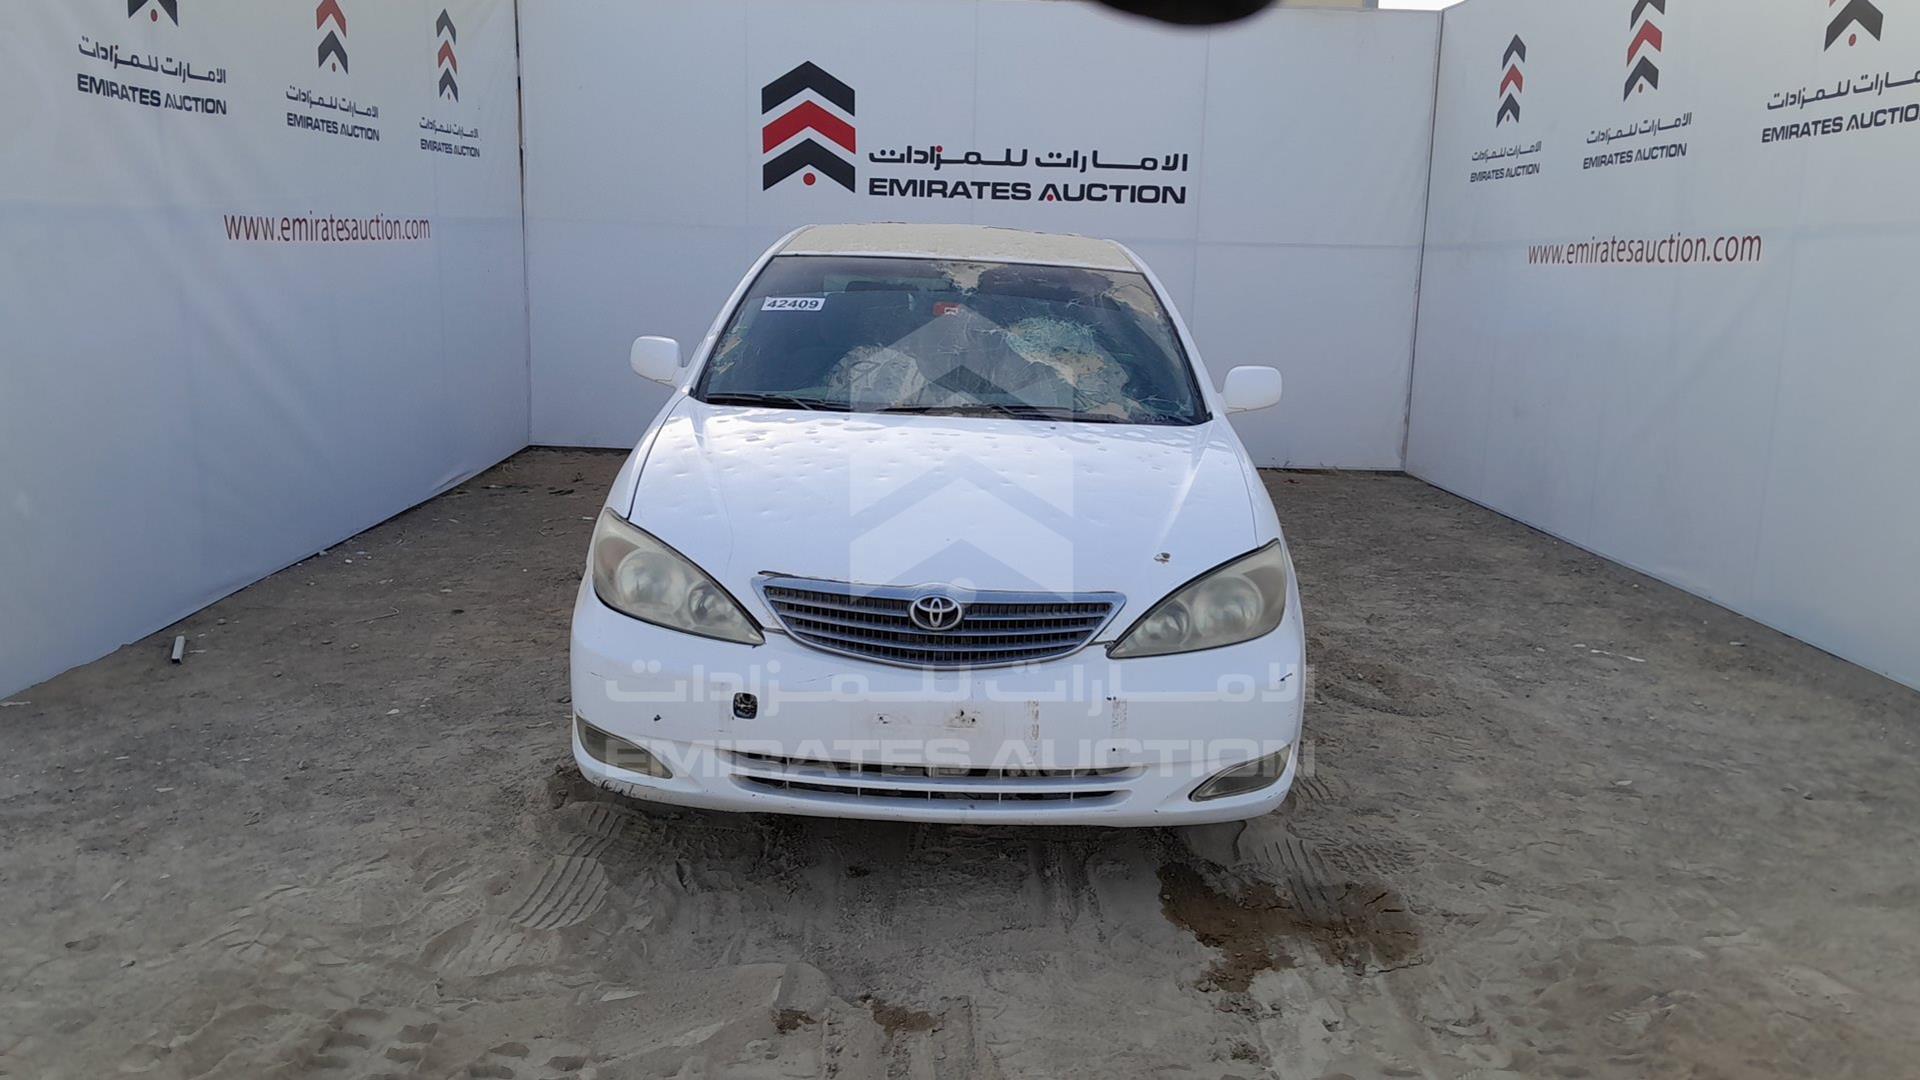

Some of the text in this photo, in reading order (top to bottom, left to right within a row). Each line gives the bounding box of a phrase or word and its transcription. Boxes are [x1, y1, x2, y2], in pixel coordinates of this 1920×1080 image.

[78, 35, 226, 84] الامارات للمزادات
[77, 73, 227, 115] EMIRATES AUCTION
[1767, 79, 1850, 110] للمزادات
[286, 112, 380, 141] EMIRATES AUCTION
[1761, 103, 1920, 143] EMIRATES AUCTIO
[420, 138, 480, 157] EMIRATES AUCTION
[869, 145, 1188, 173] الامارات للمزادات
[1583, 143, 1687, 169] EMIRATES AUCTION
[1470, 163, 1540, 182] EMIRATES AUCTION
[868, 178, 1186, 204] EMIRATES AUCTION
[223, 210, 431, 243] www.emiratesauction.com
[1527, 232, 1762, 265] www.emiratesauction.com
[767, 300, 819, 309] 42409
